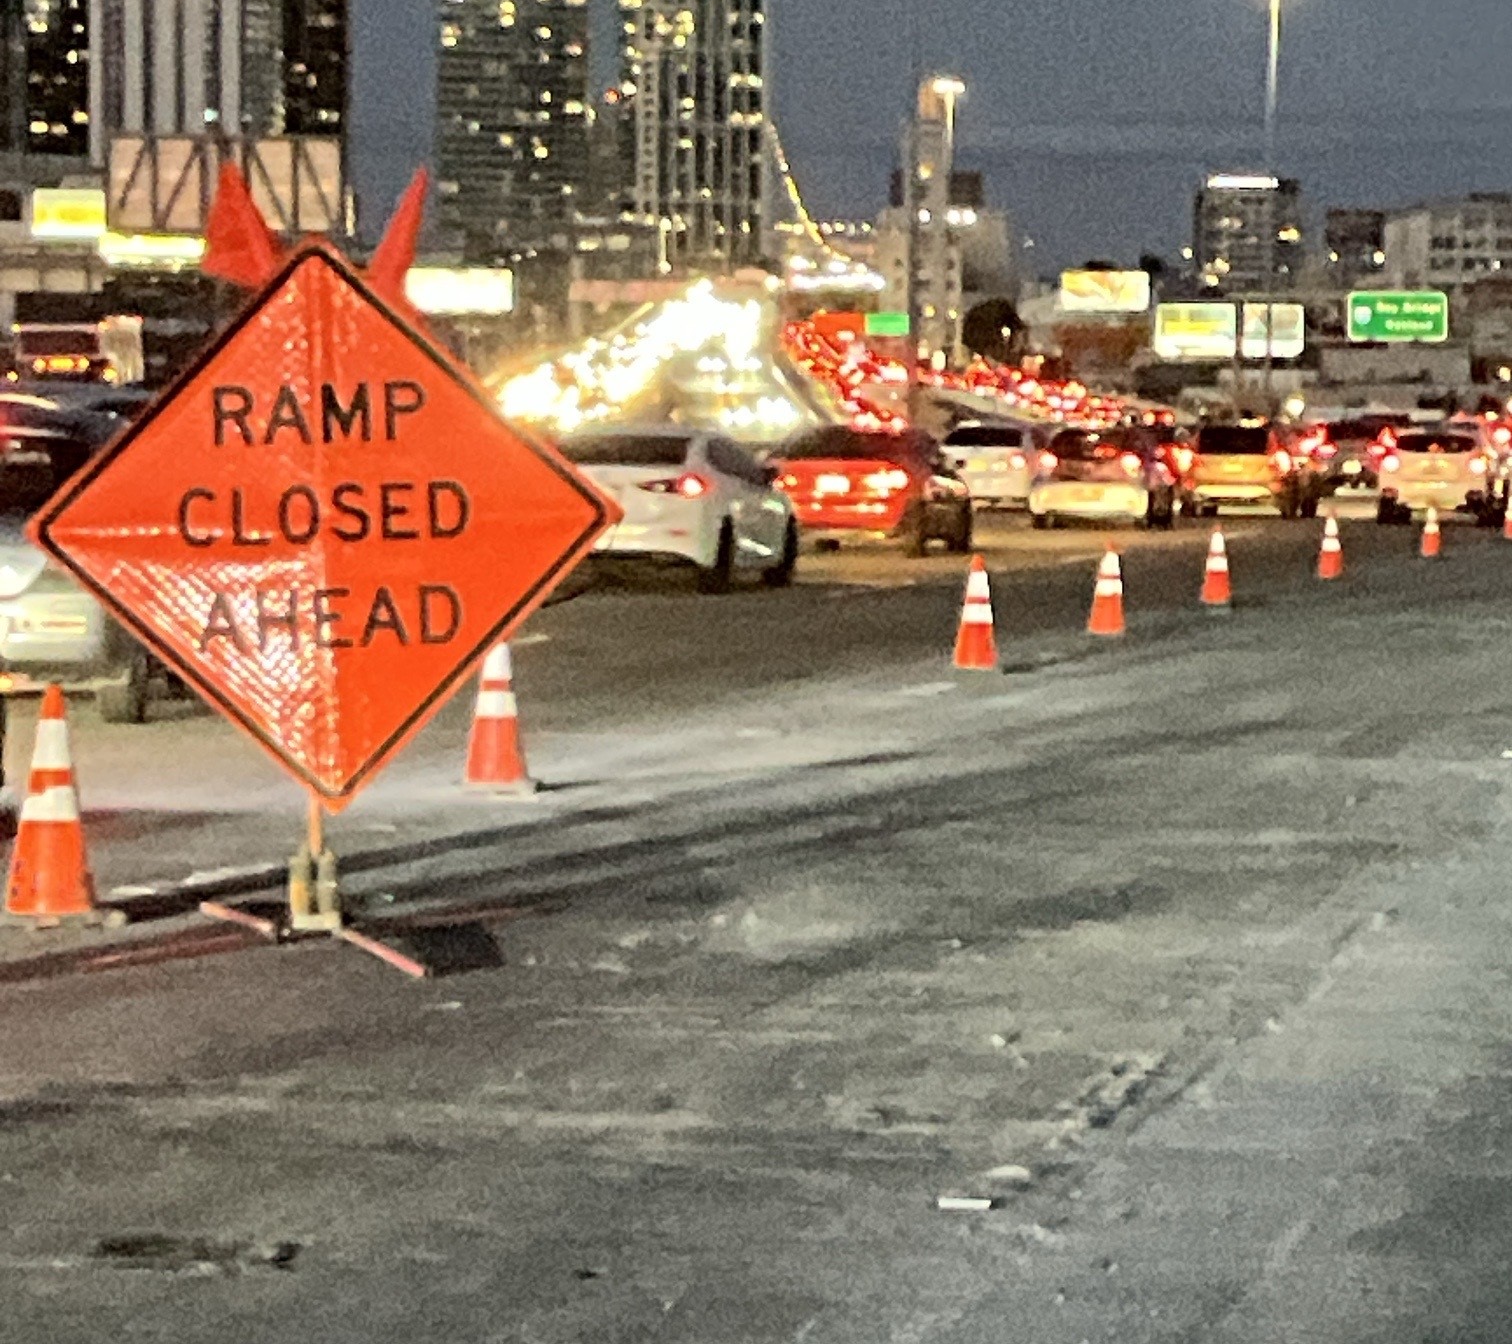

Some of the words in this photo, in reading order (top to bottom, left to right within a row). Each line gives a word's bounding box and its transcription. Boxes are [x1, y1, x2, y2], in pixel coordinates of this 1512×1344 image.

[212, 380, 427, 447] RAMP
[177, 479, 471, 547] CLOSED
[199, 584, 464, 650] AHEAD
